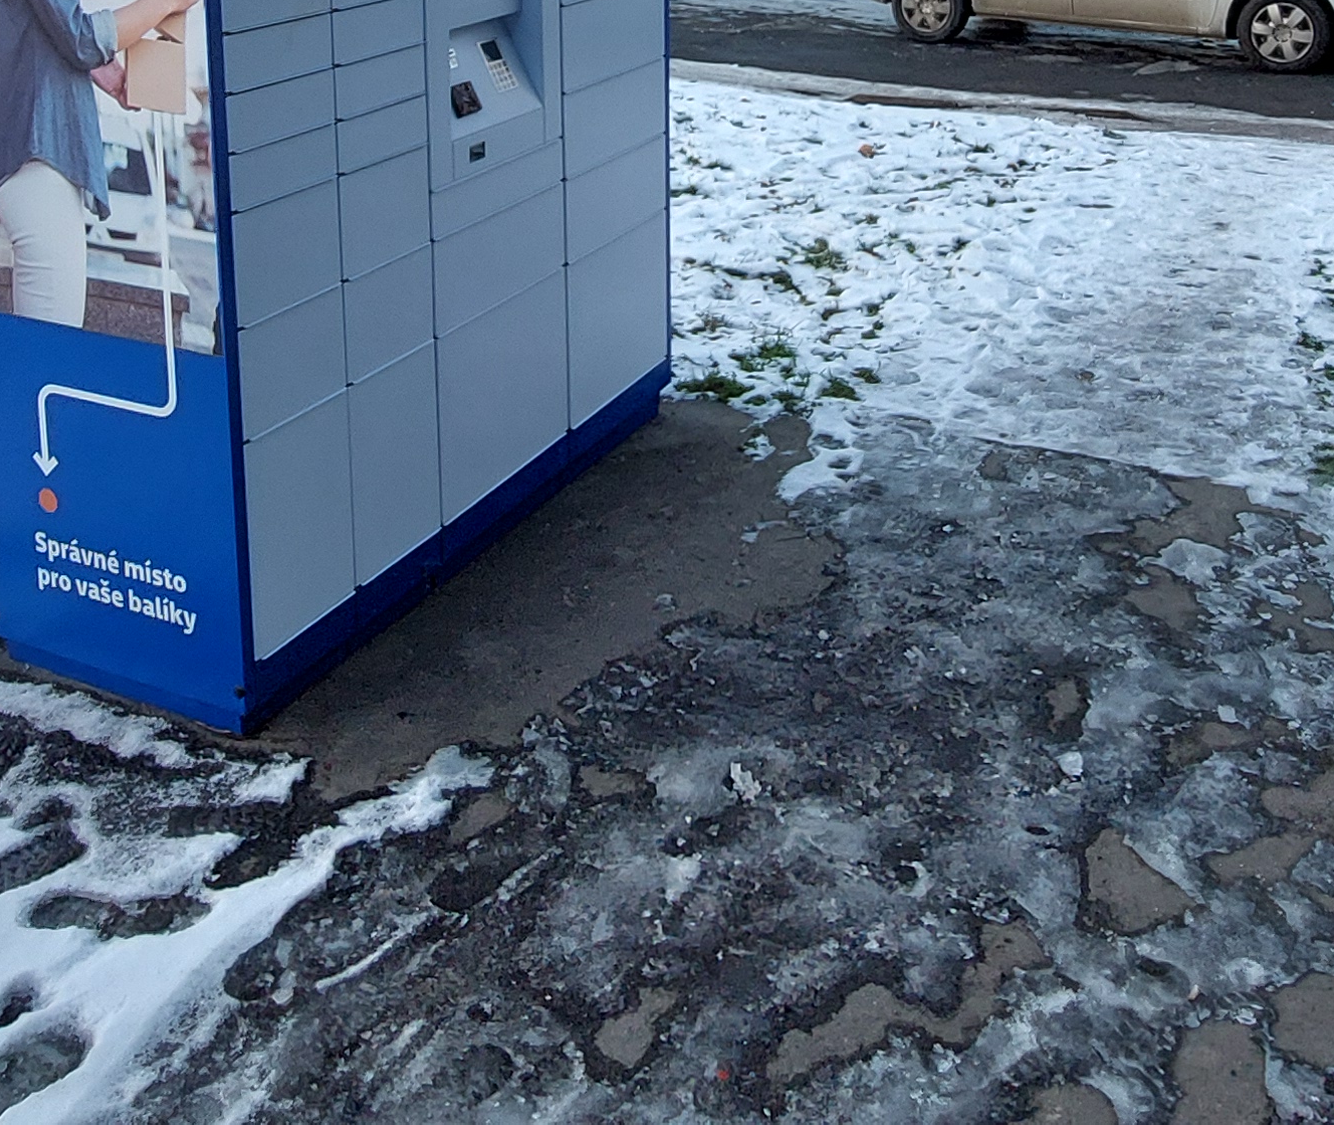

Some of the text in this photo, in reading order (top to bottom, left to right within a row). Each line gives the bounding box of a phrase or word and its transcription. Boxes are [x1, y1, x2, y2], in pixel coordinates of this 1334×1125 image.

[34, 531, 188, 593] Správné místo
[37, 567, 197, 635] pro vaše balíky
